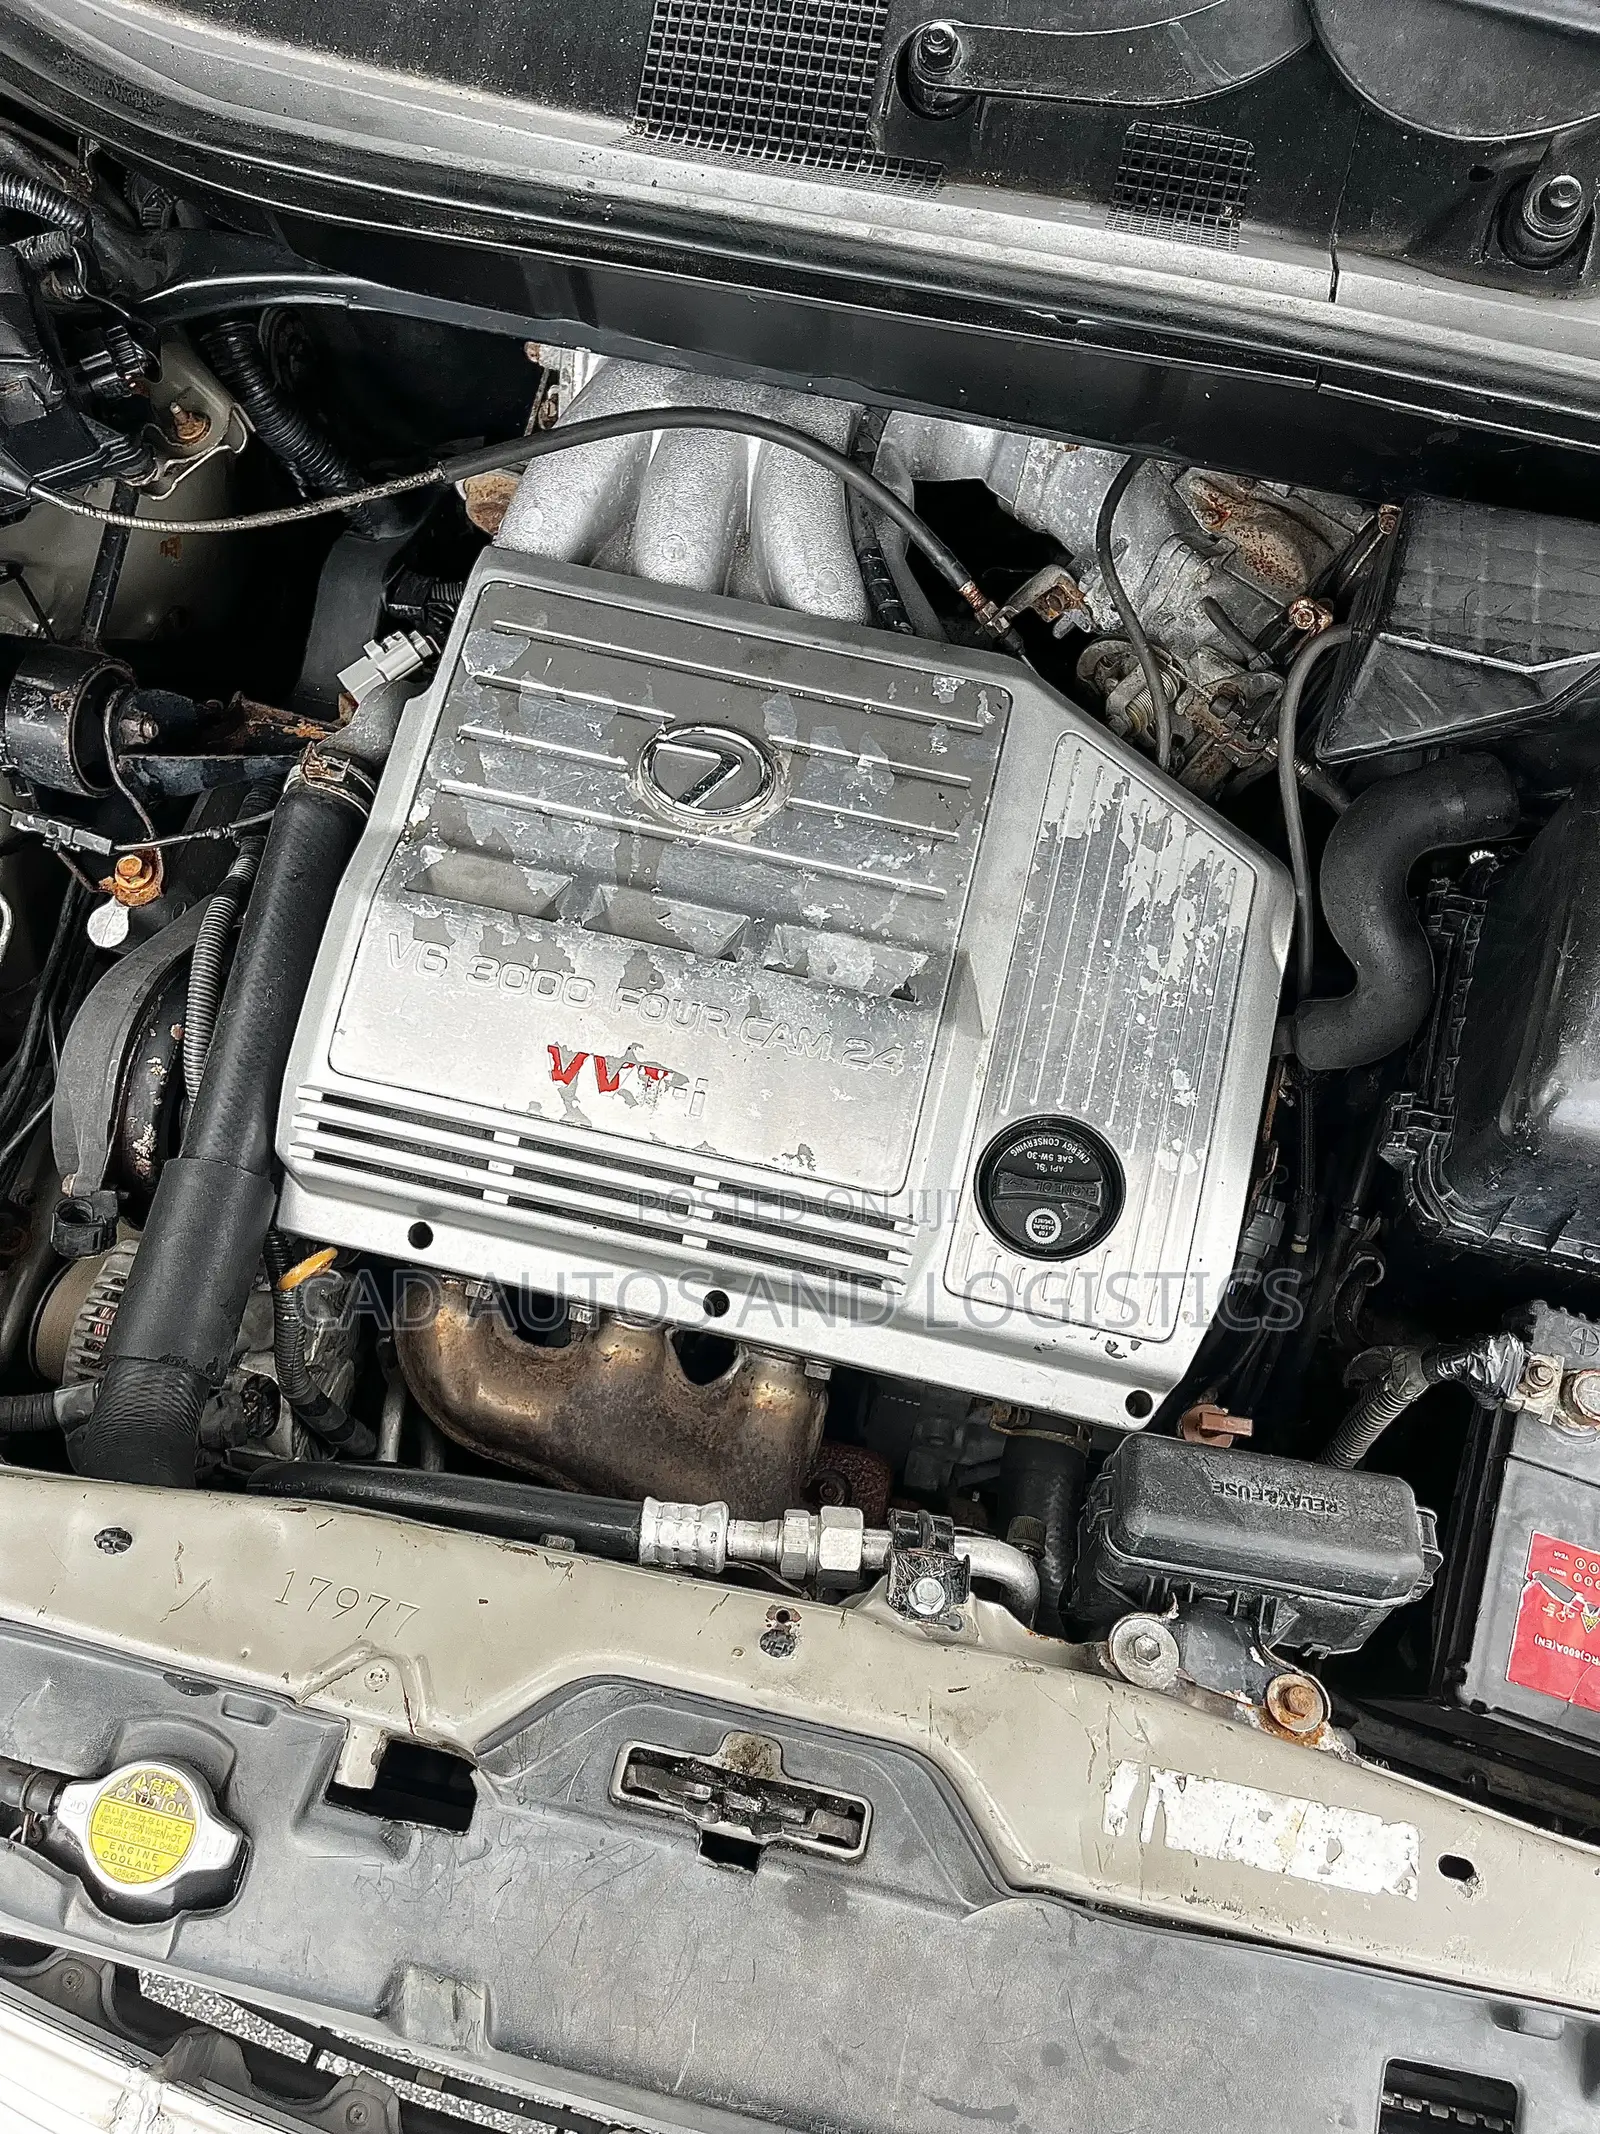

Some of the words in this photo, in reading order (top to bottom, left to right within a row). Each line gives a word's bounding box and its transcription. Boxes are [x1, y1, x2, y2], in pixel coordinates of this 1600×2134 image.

[388, 932, 451, 978] V6
[465, 954, 596, 1010] 3000
[610, 984, 731, 1041] FOUR
[738, 1015, 834, 1064] CAM
[841, 1036, 906, 1076] 24
[1009, 1137, 1060, 1157] CONSERVING
[1026, 1150, 1055, 1163] 5W-30
[1061, 1141, 1091, 1165] ENERGY
[1050, 1165, 1065, 1173] API
[1056, 1154, 1074, 1164] SAE
[1211, 1479, 1340, 1514] RELAY&FUSE
[273, 1567, 421, 1638] 17977
[150, 1777, 179, 1799] 危険
[115, 1786, 188, 1816] CAUTION
[99, 1814, 124, 1830] NEVER
[124, 1821, 145, 1836] OPEN
[145, 1825, 167, 1840] WHEN
[166, 1831, 183, 1844] HOT
[101, 1850, 160, 1873] COOLANT
[109, 1841, 160, 1862] ENGINE
